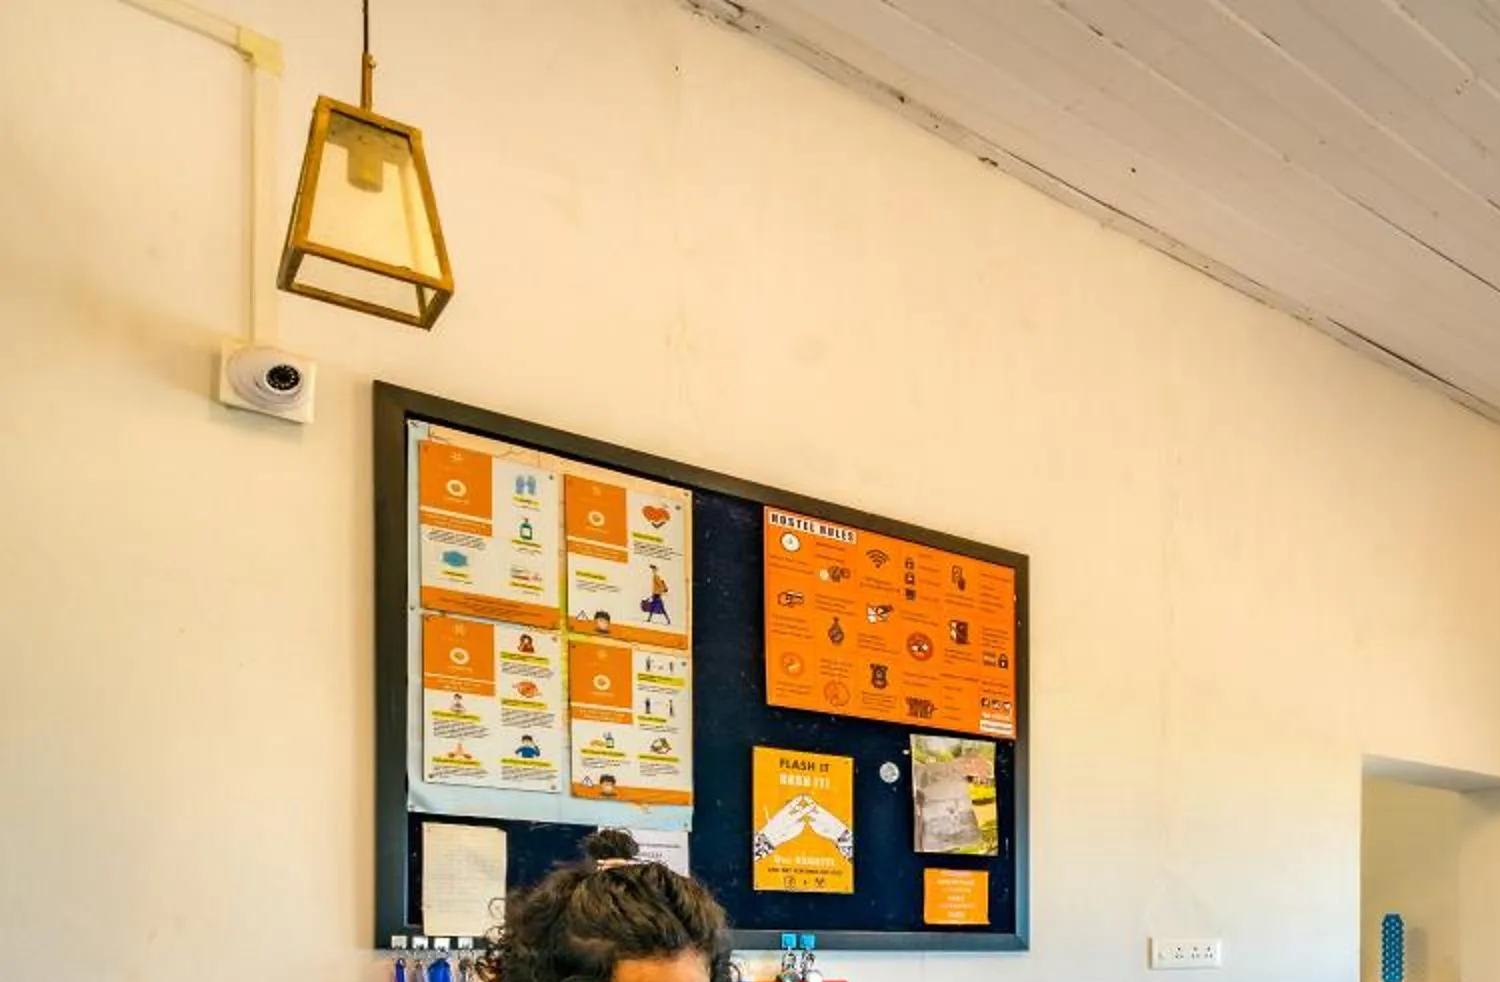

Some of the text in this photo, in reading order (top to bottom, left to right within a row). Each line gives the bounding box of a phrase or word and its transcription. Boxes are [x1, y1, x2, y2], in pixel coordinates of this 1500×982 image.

[771, 512, 855, 542] HOSTEL RULES
[779, 758, 830, 773] FLASH IT
